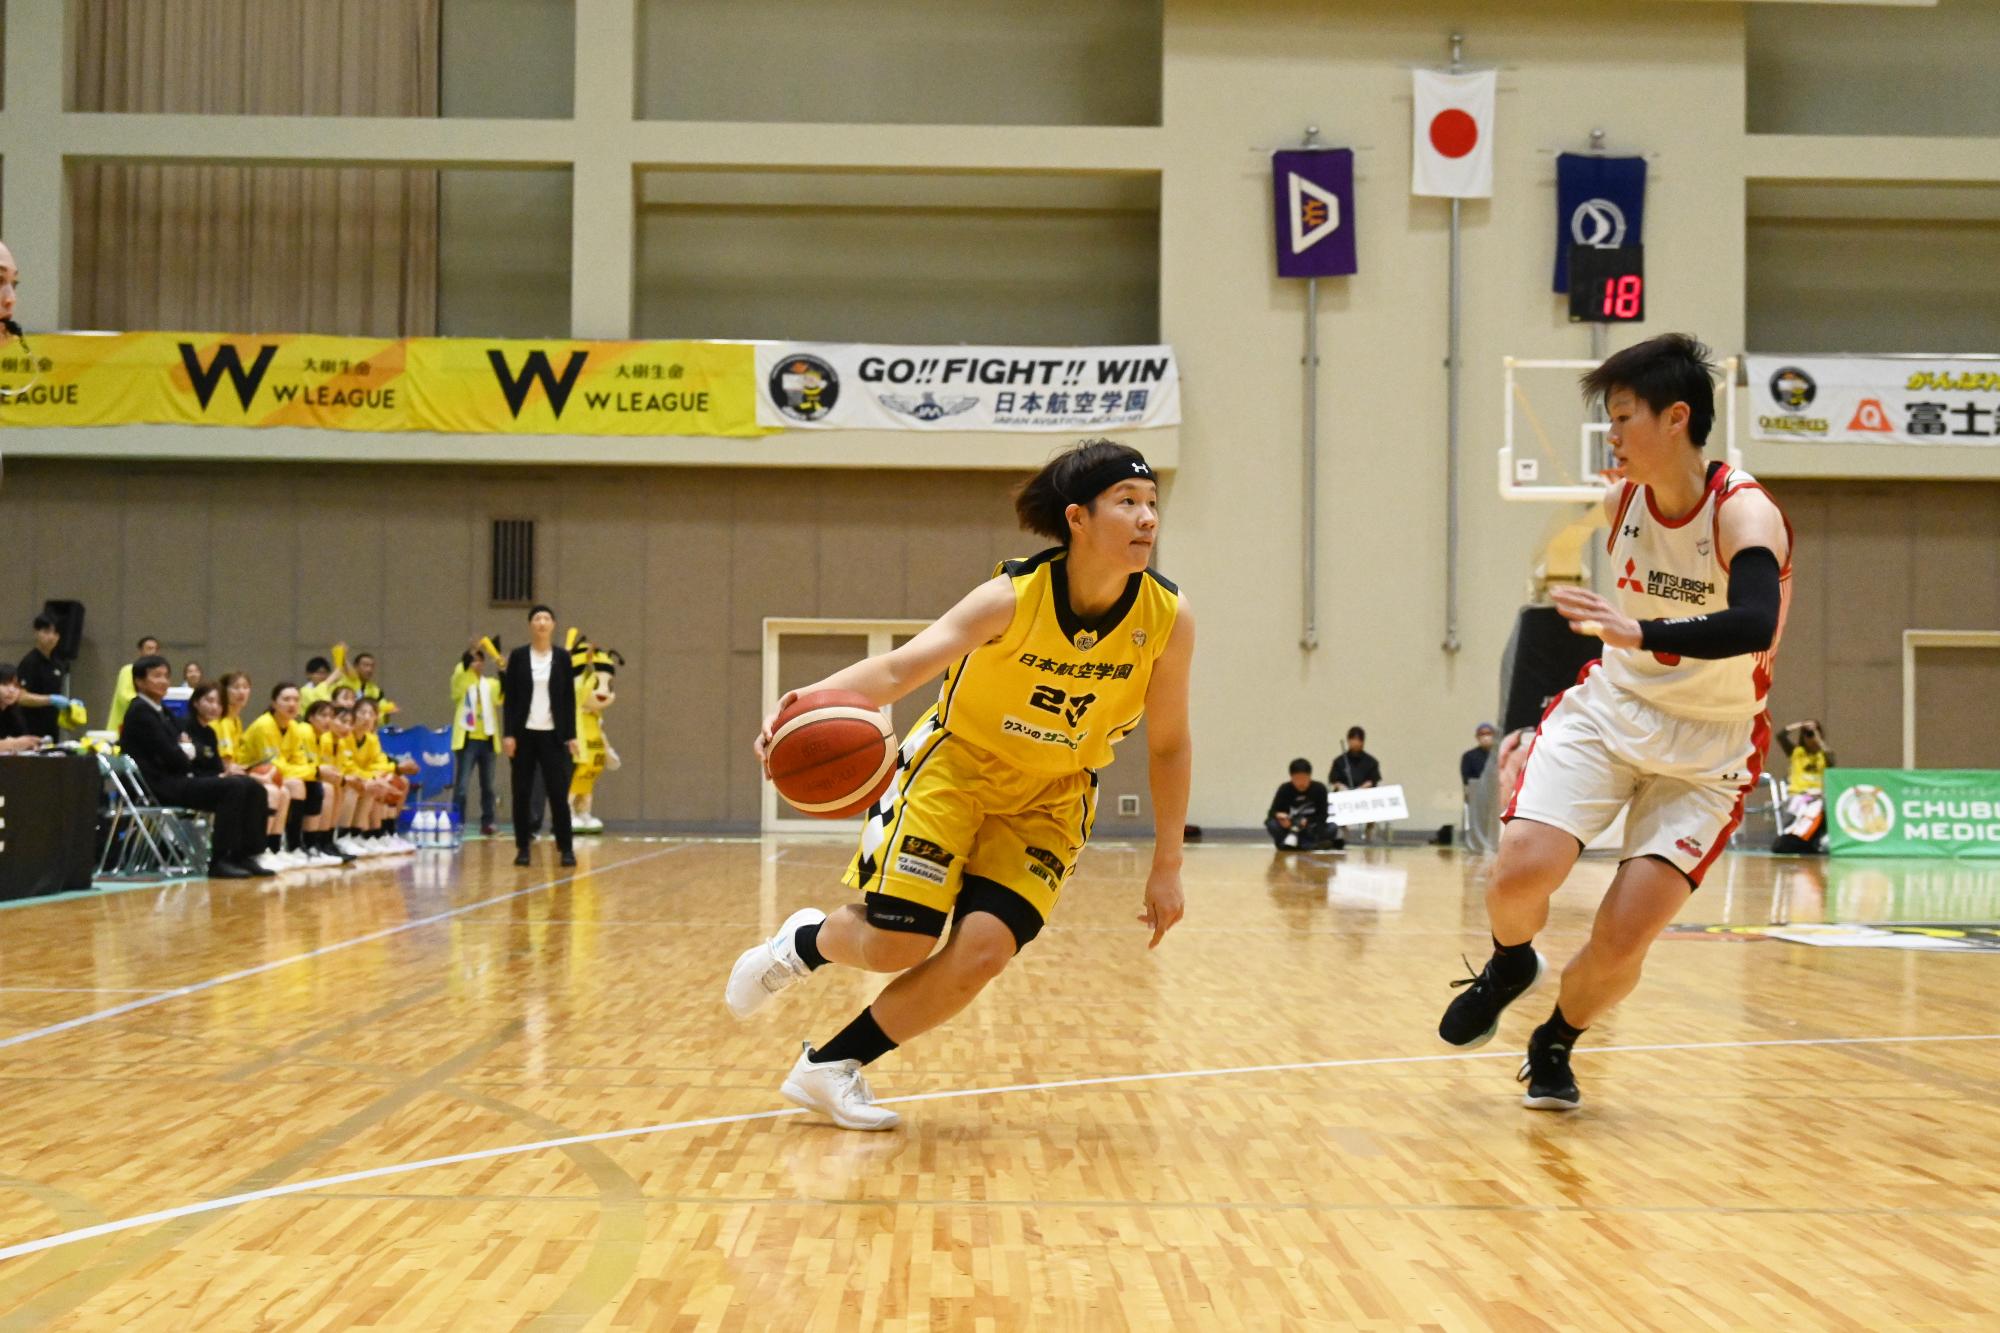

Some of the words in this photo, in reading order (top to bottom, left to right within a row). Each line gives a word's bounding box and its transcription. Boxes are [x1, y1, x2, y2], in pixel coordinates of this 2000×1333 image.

[1603, 274, 1642, 318] 18
[178, 342, 278, 414] W
[486, 349, 590, 420] W
[616, 363, 685, 380] 大樹生命
[1097, 358, 1169, 385] WIN
[273, 385, 299, 403] W
[303, 386, 395, 409] LEAGUE
[585, 392, 611, 410] W
[616, 392, 709, 412] LEAGUE
[994, 389, 1149, 414] 日本航空学園
[1905, 402, 2000, 436] 富士
[1647, 583, 1707, 606] ELECTRIC
[1648, 570, 1715, 594] MITSUBISHI
[1019, 653, 1134, 680] 日本航空学園
